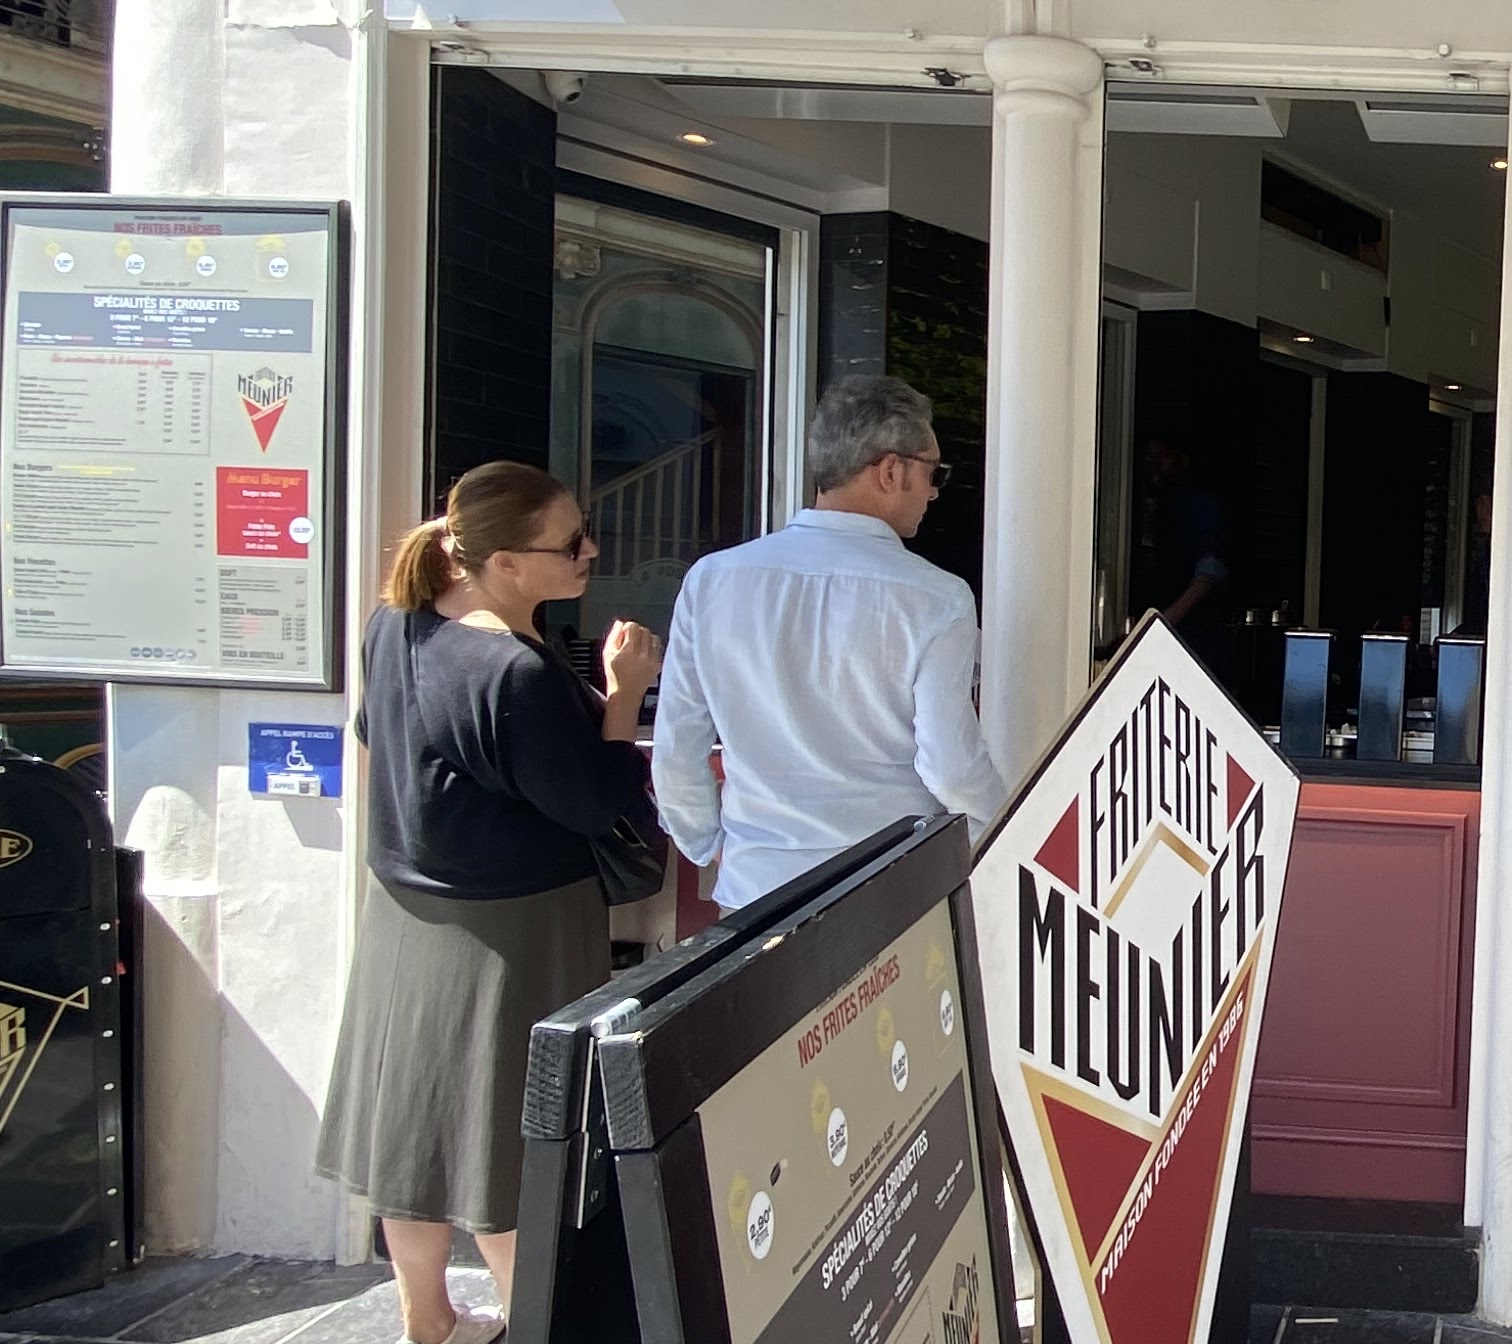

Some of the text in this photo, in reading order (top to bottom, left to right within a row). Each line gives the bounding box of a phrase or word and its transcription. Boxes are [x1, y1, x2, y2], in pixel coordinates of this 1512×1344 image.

[93, 295, 241, 312] SPÉCIALITÉS DE CROQUETTES
[237, 372, 294, 408] MEUNIER
[1090, 676, 1219, 908] FRITERIE
[797, 1022, 822, 1070] NOS
[822, 990, 858, 1046] FRITES
[1018, 782, 1264, 1118] MEUNIER
[820, 1198, 874, 1293] SPÉCIALITÉS
[873, 1184, 885, 1218] DE
[885, 1125, 928, 1205] CROQUETTES
[1101, 1173, 1152, 1294] MAISON
[1201, 1043, 1217, 1090] EN
[1218, 990, 1244, 1053] 1986
